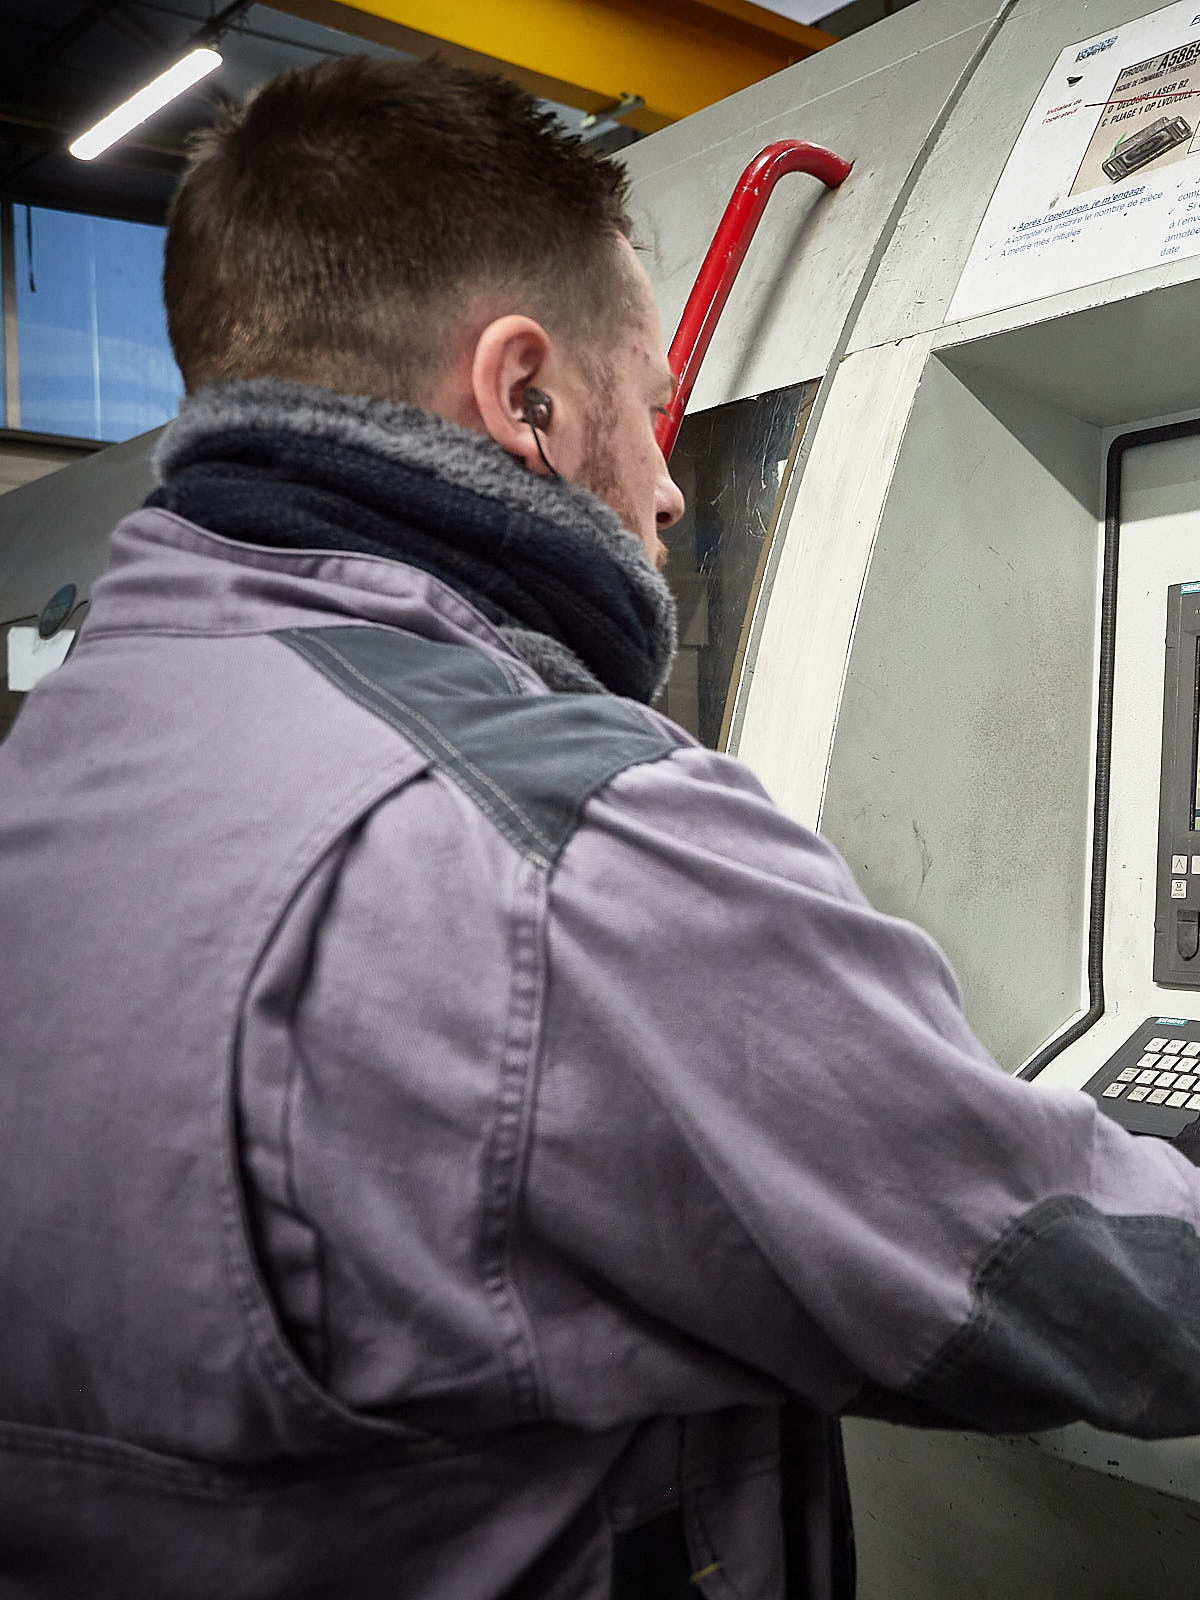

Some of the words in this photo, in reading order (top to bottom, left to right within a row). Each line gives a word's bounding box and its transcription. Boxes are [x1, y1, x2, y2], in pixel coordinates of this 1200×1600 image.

[1110, 110, 1137, 124] PLIAGE
[1145, 102, 1156, 112] OP
[1012, 227, 1044, 243] compter
[1044, 224, 1052, 233] et
[1052, 215, 1084, 232] inscrire
[1084, 213, 1092, 222] le
[1093, 204, 1125, 220] nombre
[1127, 199, 1137, 208] de
[1139, 191, 1163, 207] pièce
[1017, 217, 1042, 231] Après
[1090, 199, 1100, 210] je
[1102, 185, 1146, 204] m'engage
[1186, 203, 1196, 212] Si
[1164, 225, 1200, 243] annotée
[1169, 220, 1175, 229] à
[1007, 243, 1032, 256] mettre
[1051, 228, 1082, 243] initiales
[1160, 245, 1181, 257] date
